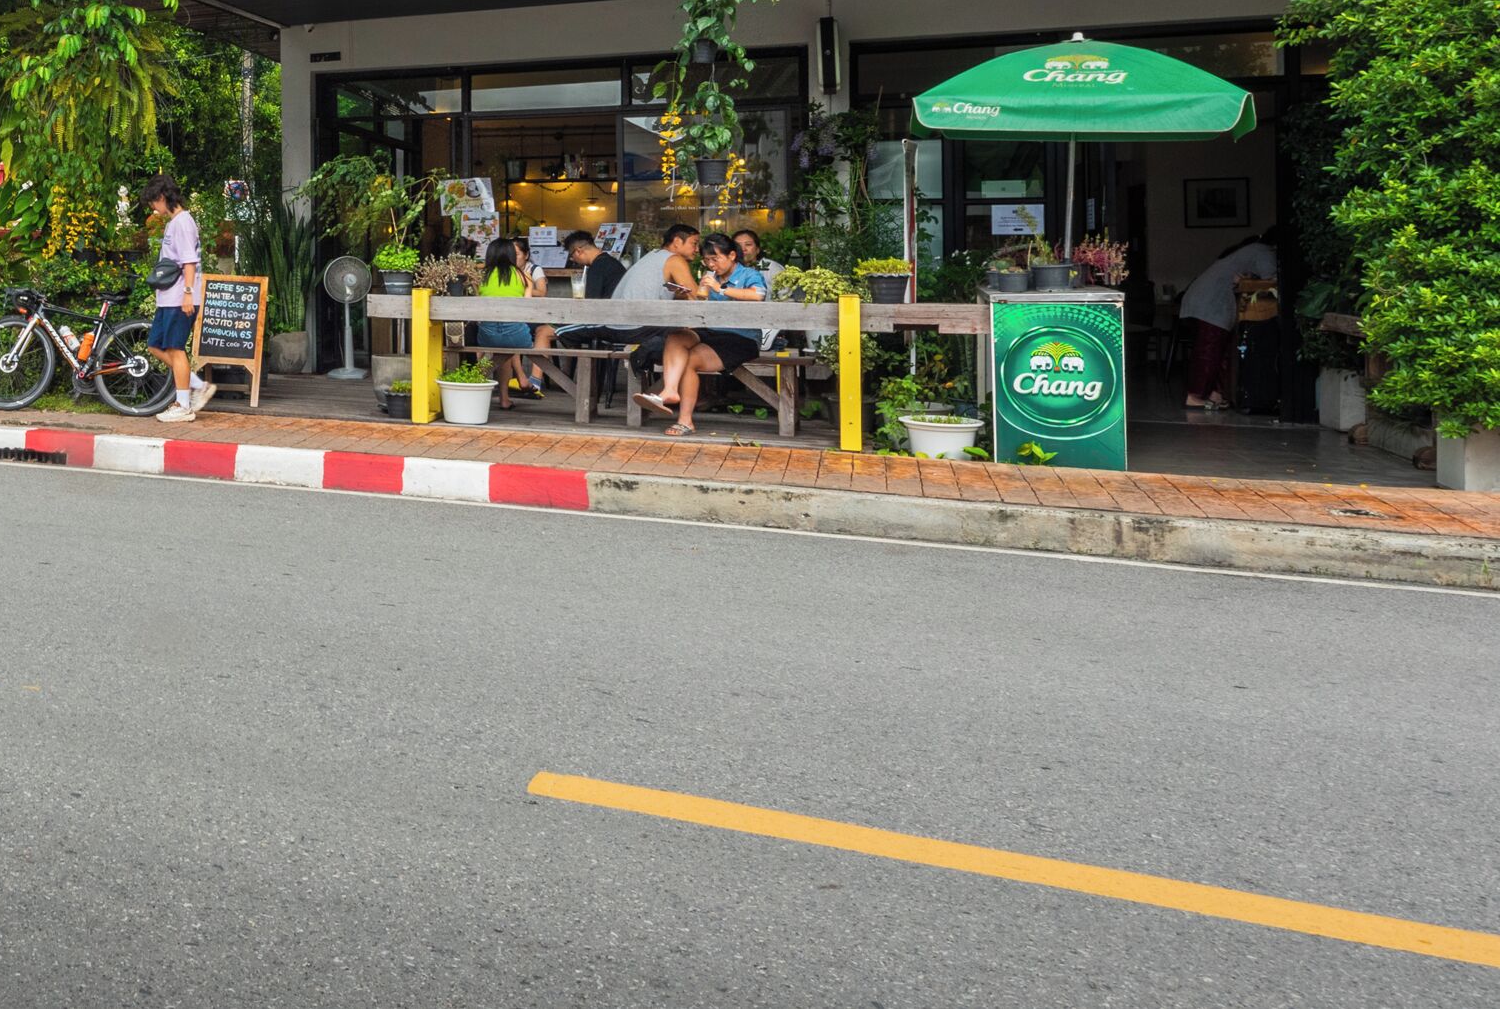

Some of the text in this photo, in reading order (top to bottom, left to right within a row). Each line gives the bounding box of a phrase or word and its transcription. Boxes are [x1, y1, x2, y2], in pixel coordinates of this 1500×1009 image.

[1023, 69, 1127, 84] Chang
[953, 102, 1000, 117] Chang
[208, 283, 258, 293] COFFEE 50-70
[204, 307, 256, 319] BEER 60-120
[203, 318, 232, 327] MOJITO
[203, 326, 252, 339] KOMBUCHA 65
[201, 337, 225, 347] LATTE
[243, 341, 253, 349] 70
[1013, 373, 1103, 401] Chang
